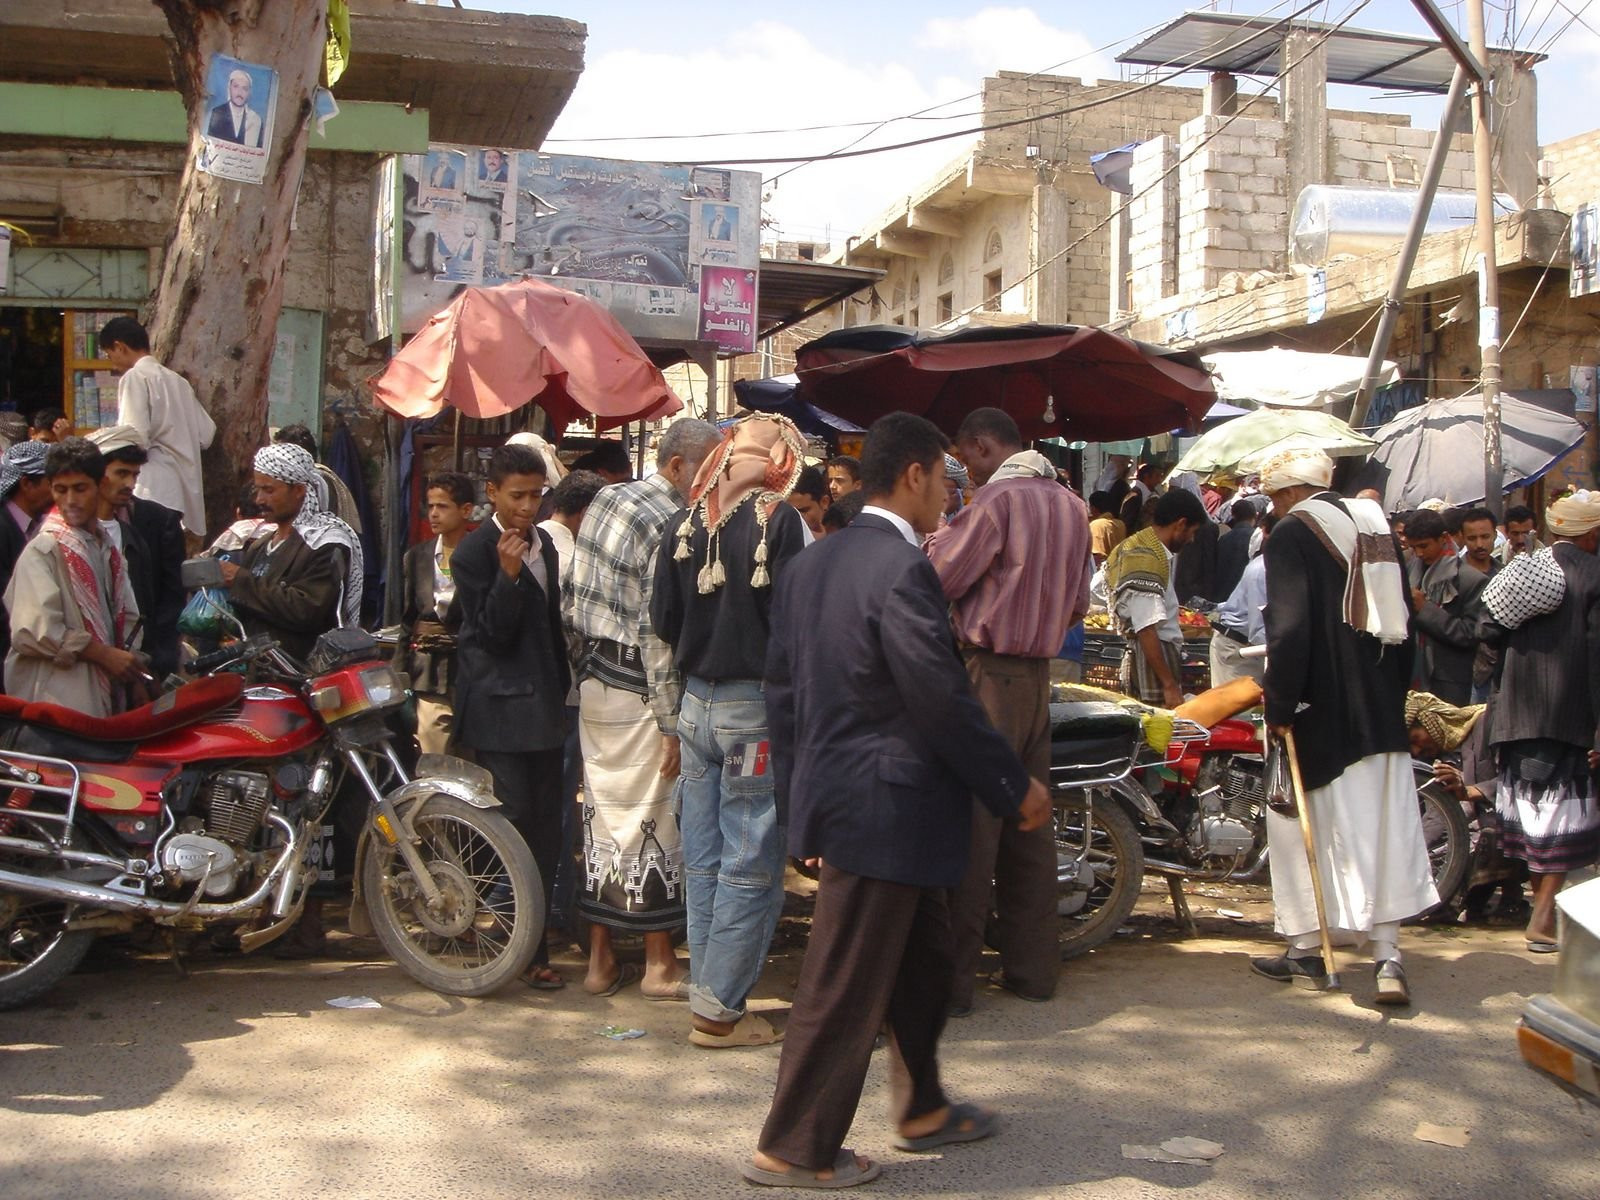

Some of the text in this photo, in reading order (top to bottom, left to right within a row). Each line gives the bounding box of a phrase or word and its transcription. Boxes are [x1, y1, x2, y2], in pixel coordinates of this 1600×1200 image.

[722, 277, 736, 296] لا
[703, 298, 752, 315] للتطرف
[704, 318, 751, 336] والغلو
